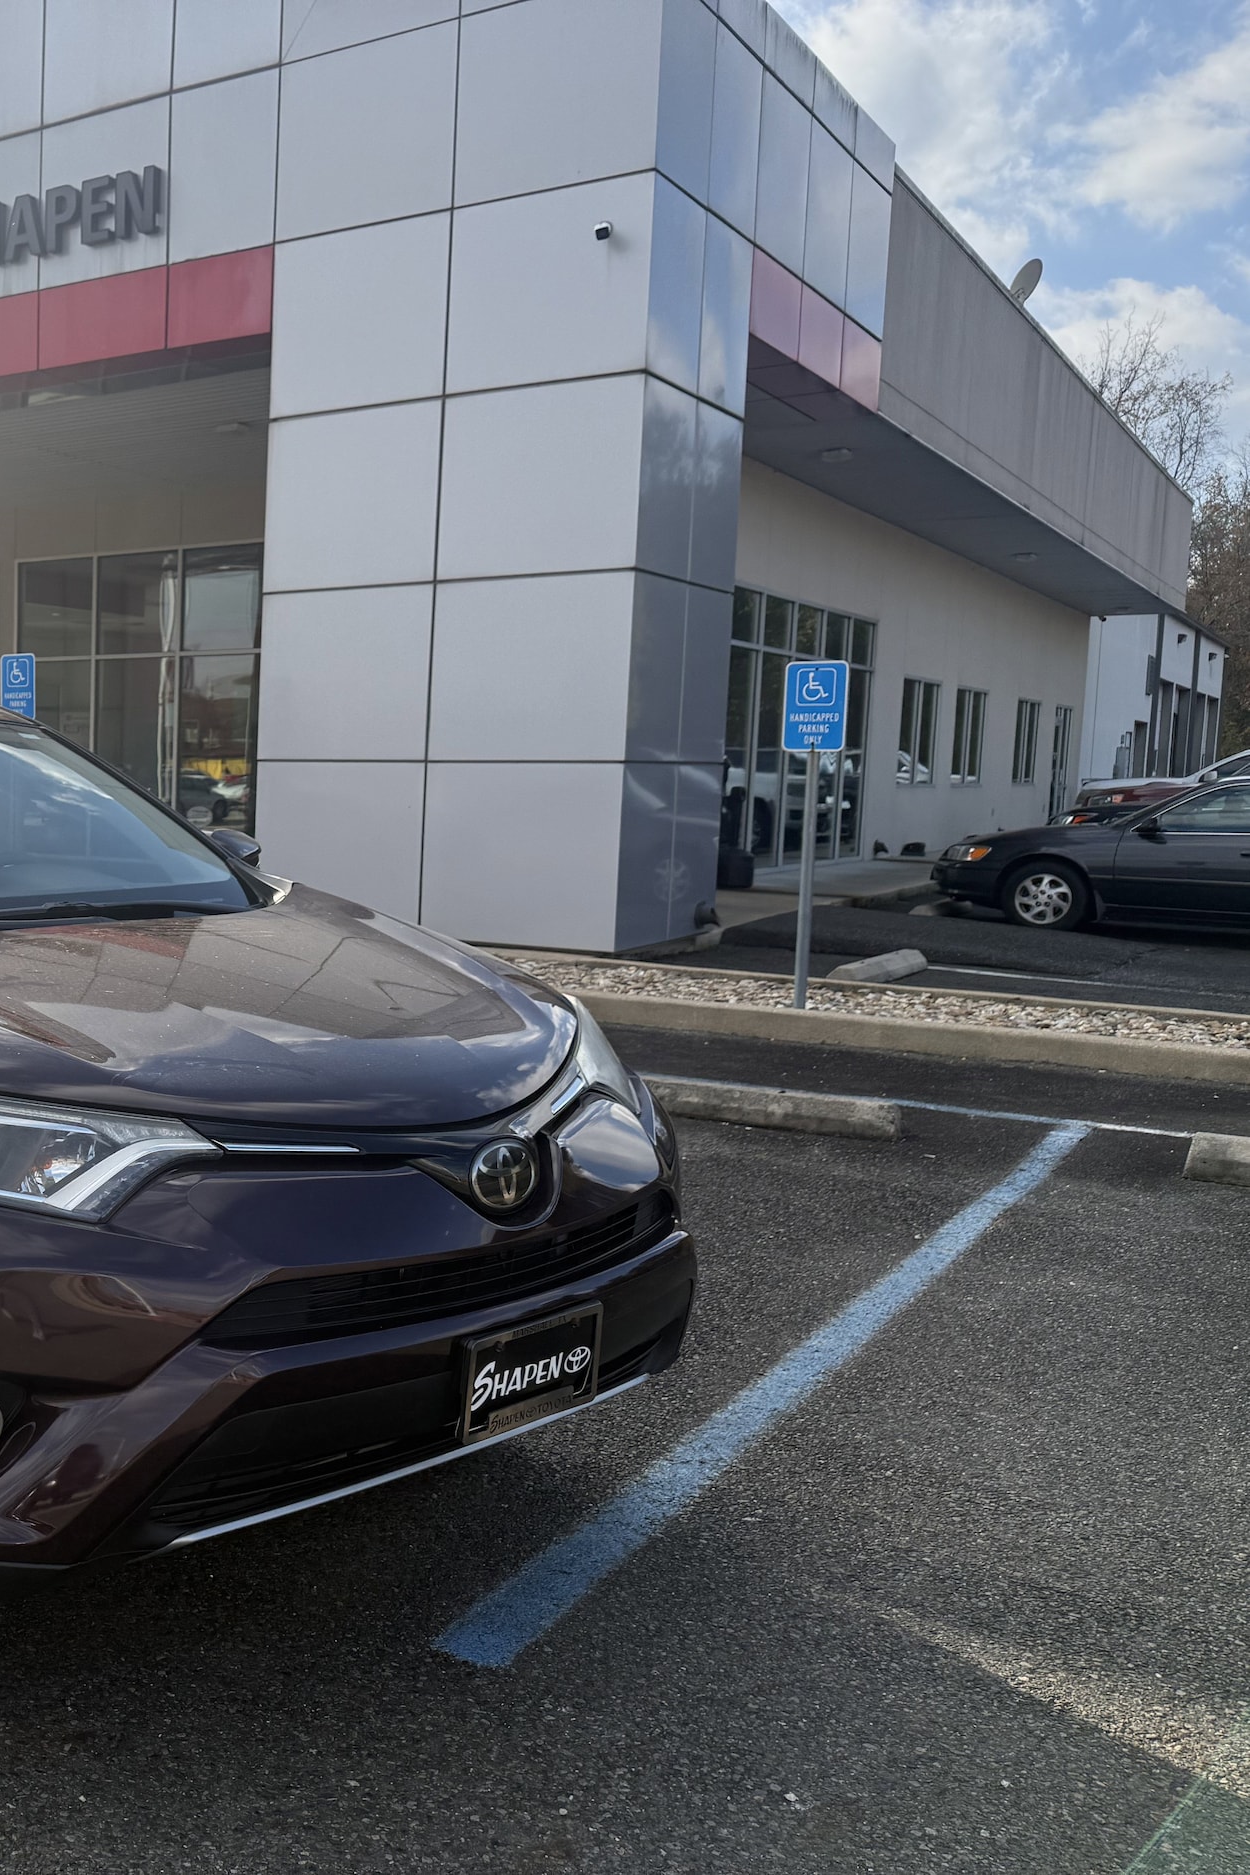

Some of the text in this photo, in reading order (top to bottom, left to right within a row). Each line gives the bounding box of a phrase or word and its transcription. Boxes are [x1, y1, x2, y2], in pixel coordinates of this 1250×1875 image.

[790, 712, 840, 723] HANDICAPPED
[798, 723, 830, 734] PARKING
[803, 735, 823, 745] ONLY
[470, 1352, 564, 1412] SHAPEN
[490, 1394, 573, 1434] SHAPEN TOYOTA
